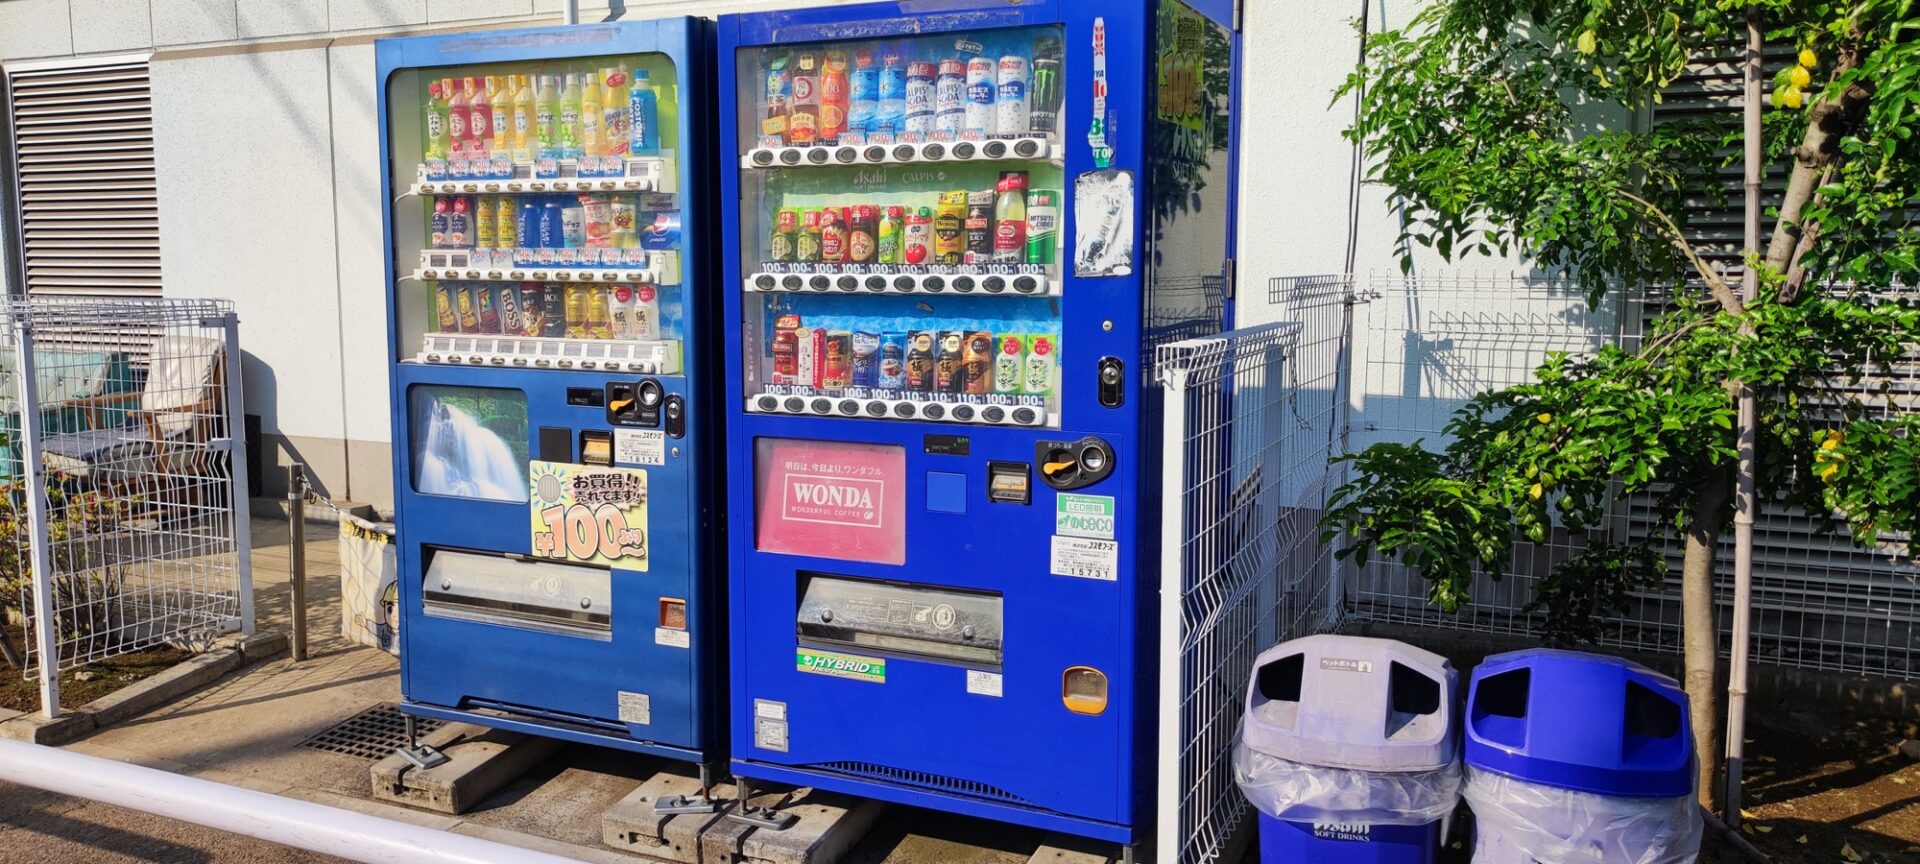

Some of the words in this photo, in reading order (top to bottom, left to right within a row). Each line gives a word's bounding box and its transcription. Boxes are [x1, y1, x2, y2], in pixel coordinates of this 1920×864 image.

[902, 171, 935, 183] CALPIS
[502, 292, 520, 330] BOSS
[630, 456, 659, 464] 18124
[793, 483, 874, 508] WONDA
[792, 506, 832, 515] WONDERFUL
[834, 509, 860, 518] COFFEE
[1068, 502, 1102, 513] LED照明
[1072, 568, 1108, 578] 15731
[812, 656, 870, 673] HYBRID
[1314, 830, 1336, 838] SOFT
[1338, 832, 1370, 842] DRINKS
